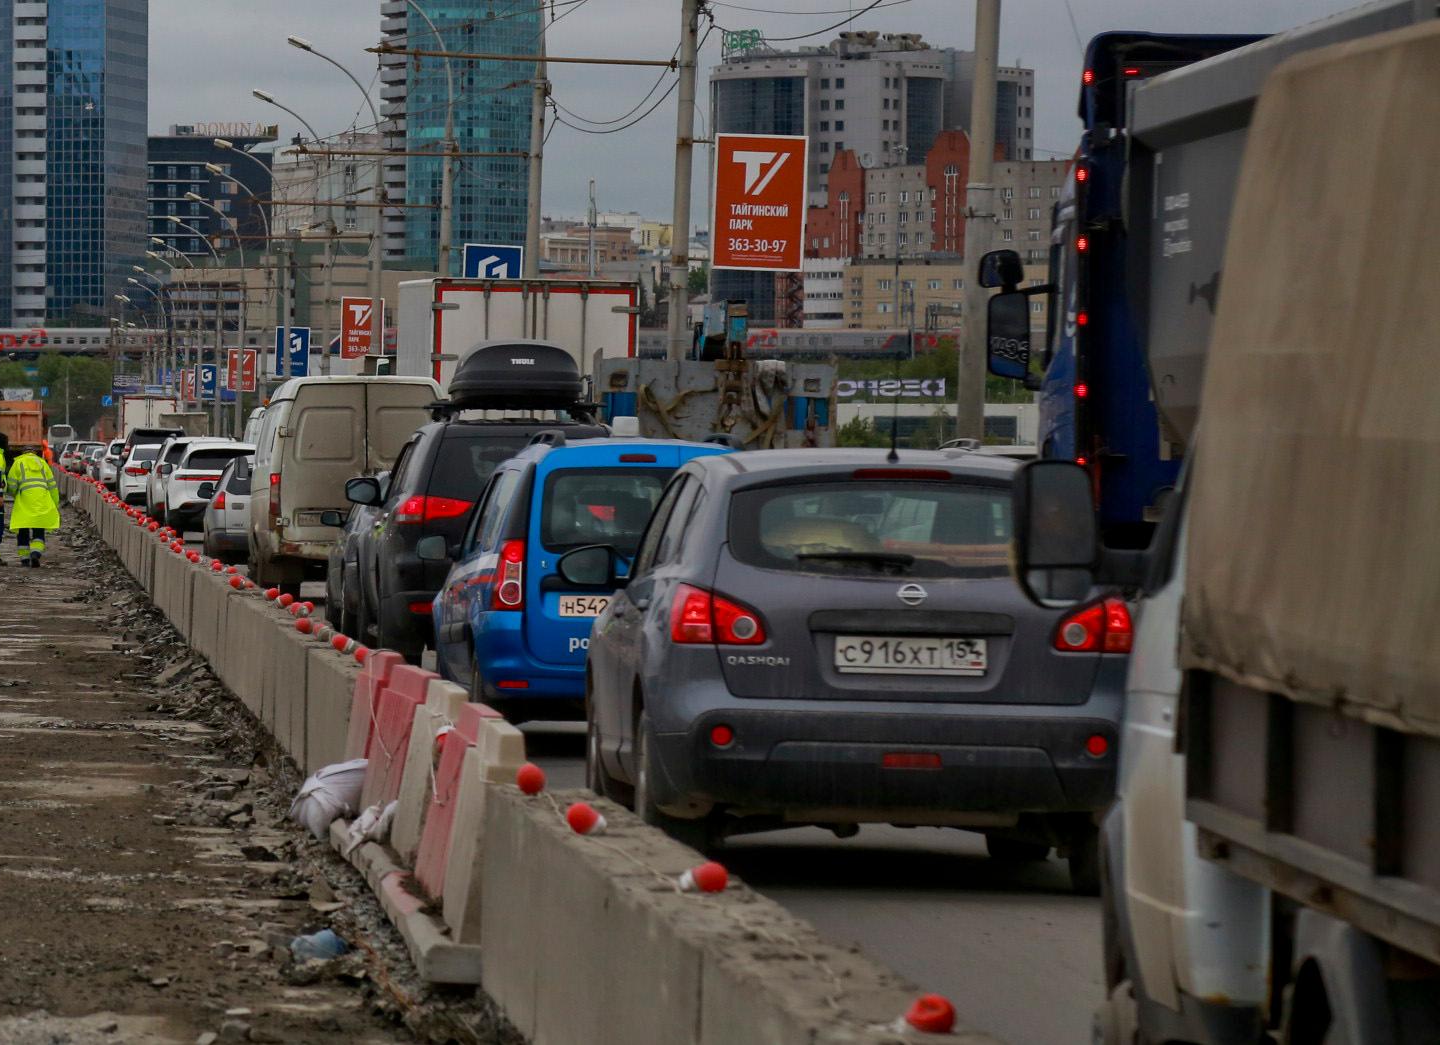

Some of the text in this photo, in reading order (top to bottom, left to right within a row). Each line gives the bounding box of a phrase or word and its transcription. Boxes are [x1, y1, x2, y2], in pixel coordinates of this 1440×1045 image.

[730, 203, 789, 217] ТАЙГИНСКИЙ
[729, 219, 753, 230] ПАРК
[728, 238, 787, 252] 363-30-97
[565, 598, 609, 614] Н542
[569, 637, 591, 653] po
[843, 640, 983, 665] С916ХТ 154
[727, 655, 791, 666] QASHQAI
